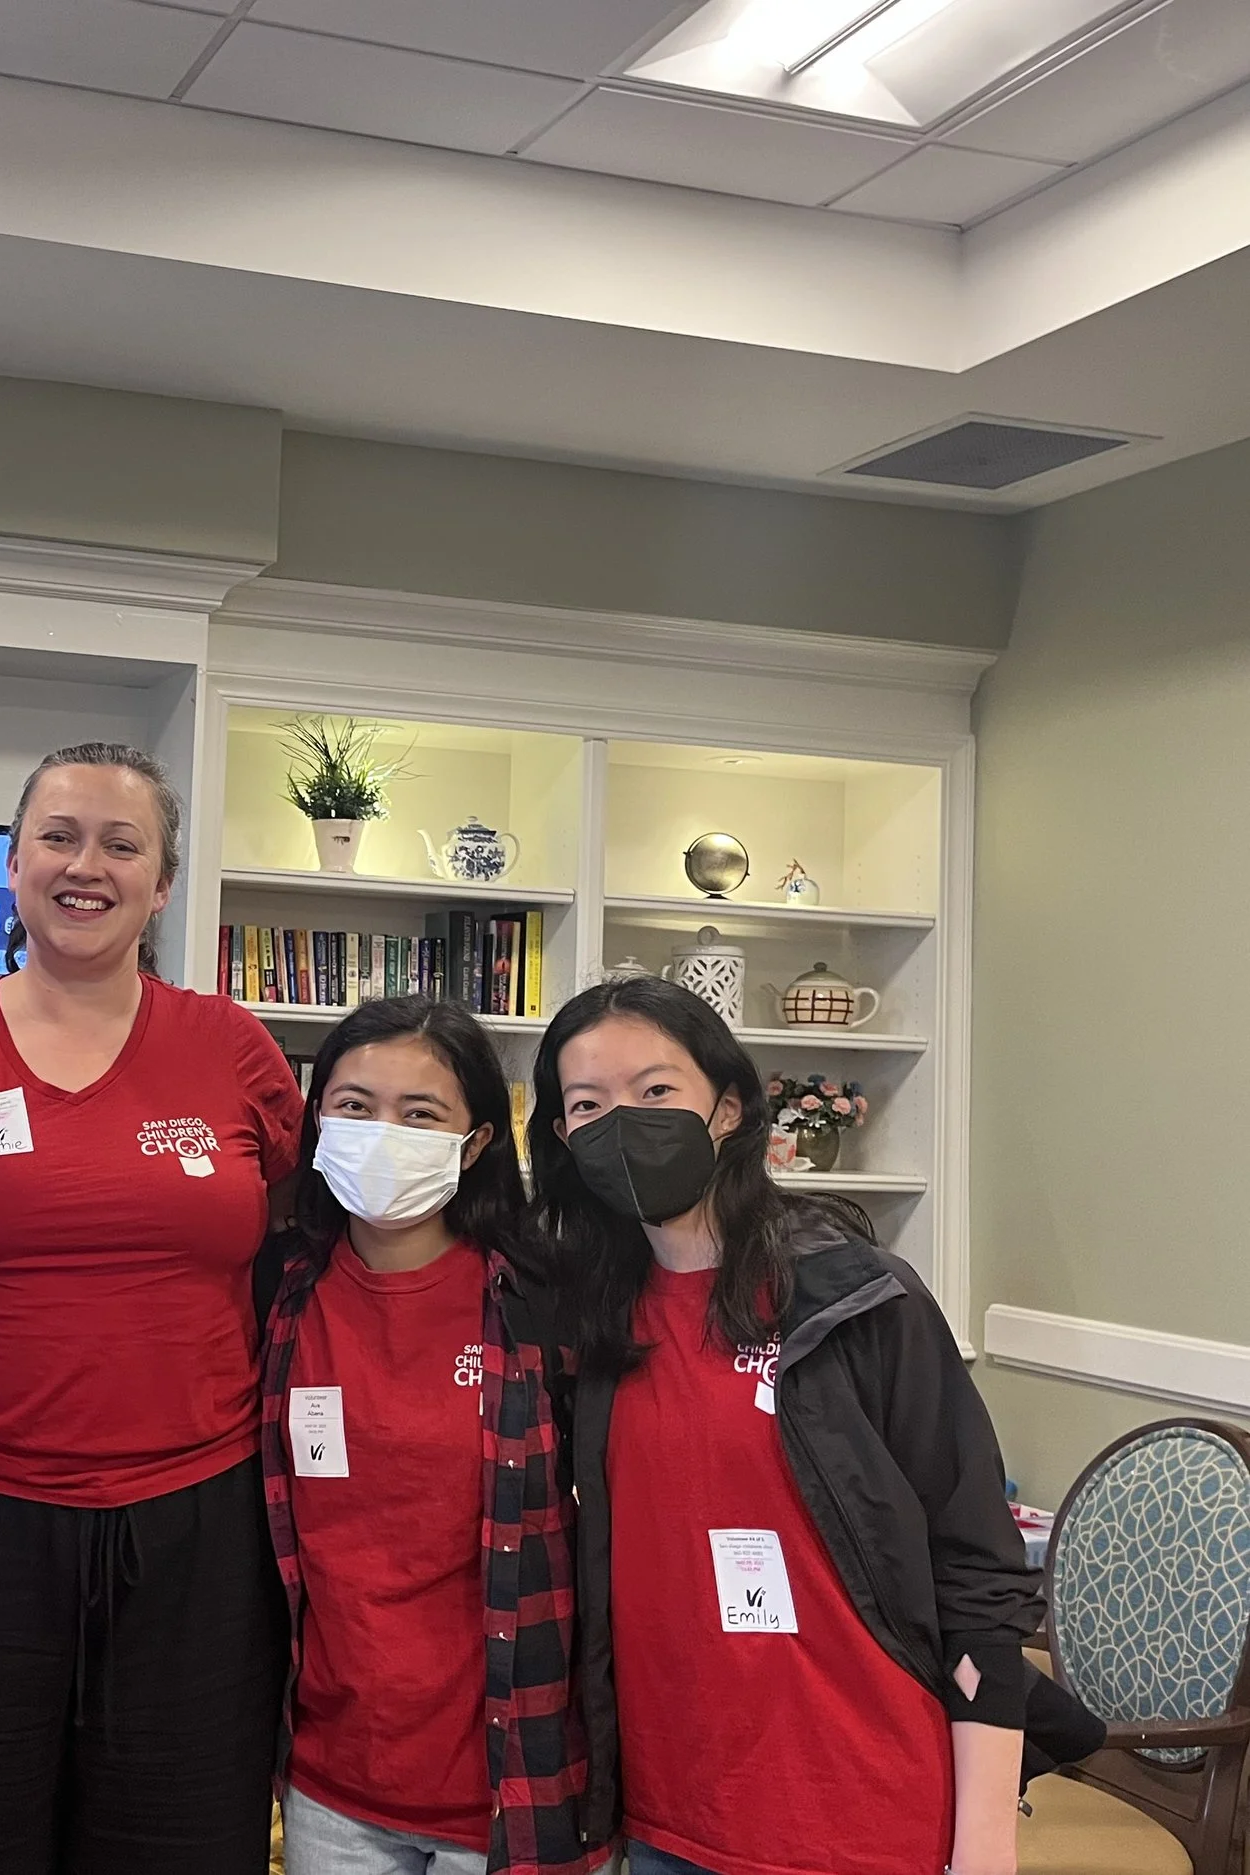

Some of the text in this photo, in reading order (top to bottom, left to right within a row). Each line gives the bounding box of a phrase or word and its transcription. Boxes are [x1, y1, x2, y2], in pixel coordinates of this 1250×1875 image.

[136, 1124, 214, 1142] CHILDREN'S
[142, 1117, 203, 1131] SAN DIEGO
[141, 1136, 221, 1158] CHOIR
[727, 1606, 780, 1630] Emily
